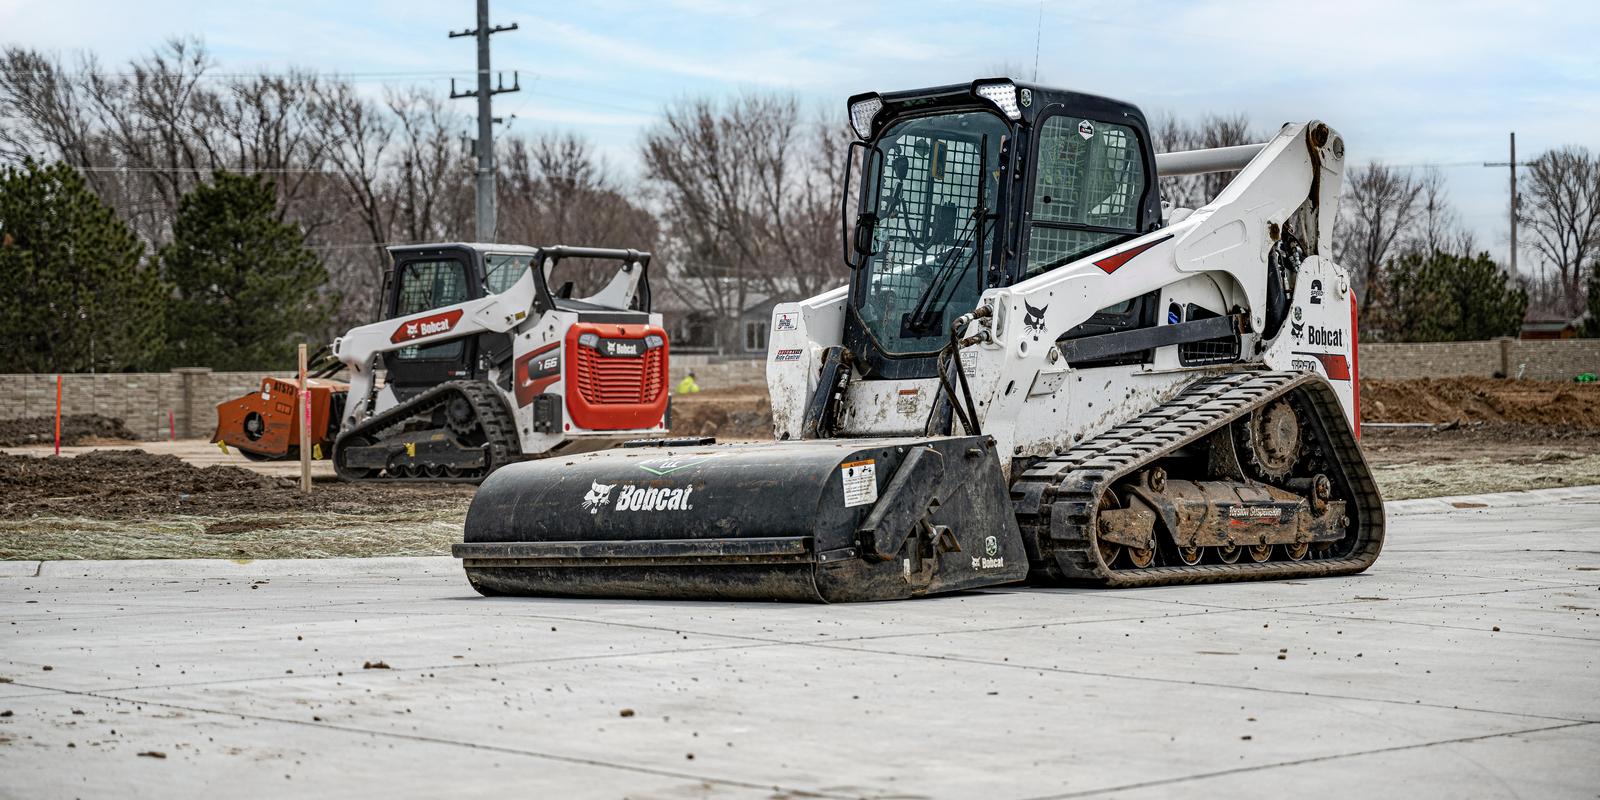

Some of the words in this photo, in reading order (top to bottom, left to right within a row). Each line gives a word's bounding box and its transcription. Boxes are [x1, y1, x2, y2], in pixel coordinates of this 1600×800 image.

[1310, 279, 1322, 305] 2
[420, 318, 449, 336] Bobcat
[1308, 325, 1343, 347] Bobcat
[616, 343, 637, 355] Bobcat
[615, 483, 693, 512] Bobcat
[981, 556, 1004, 569] Bobcat
